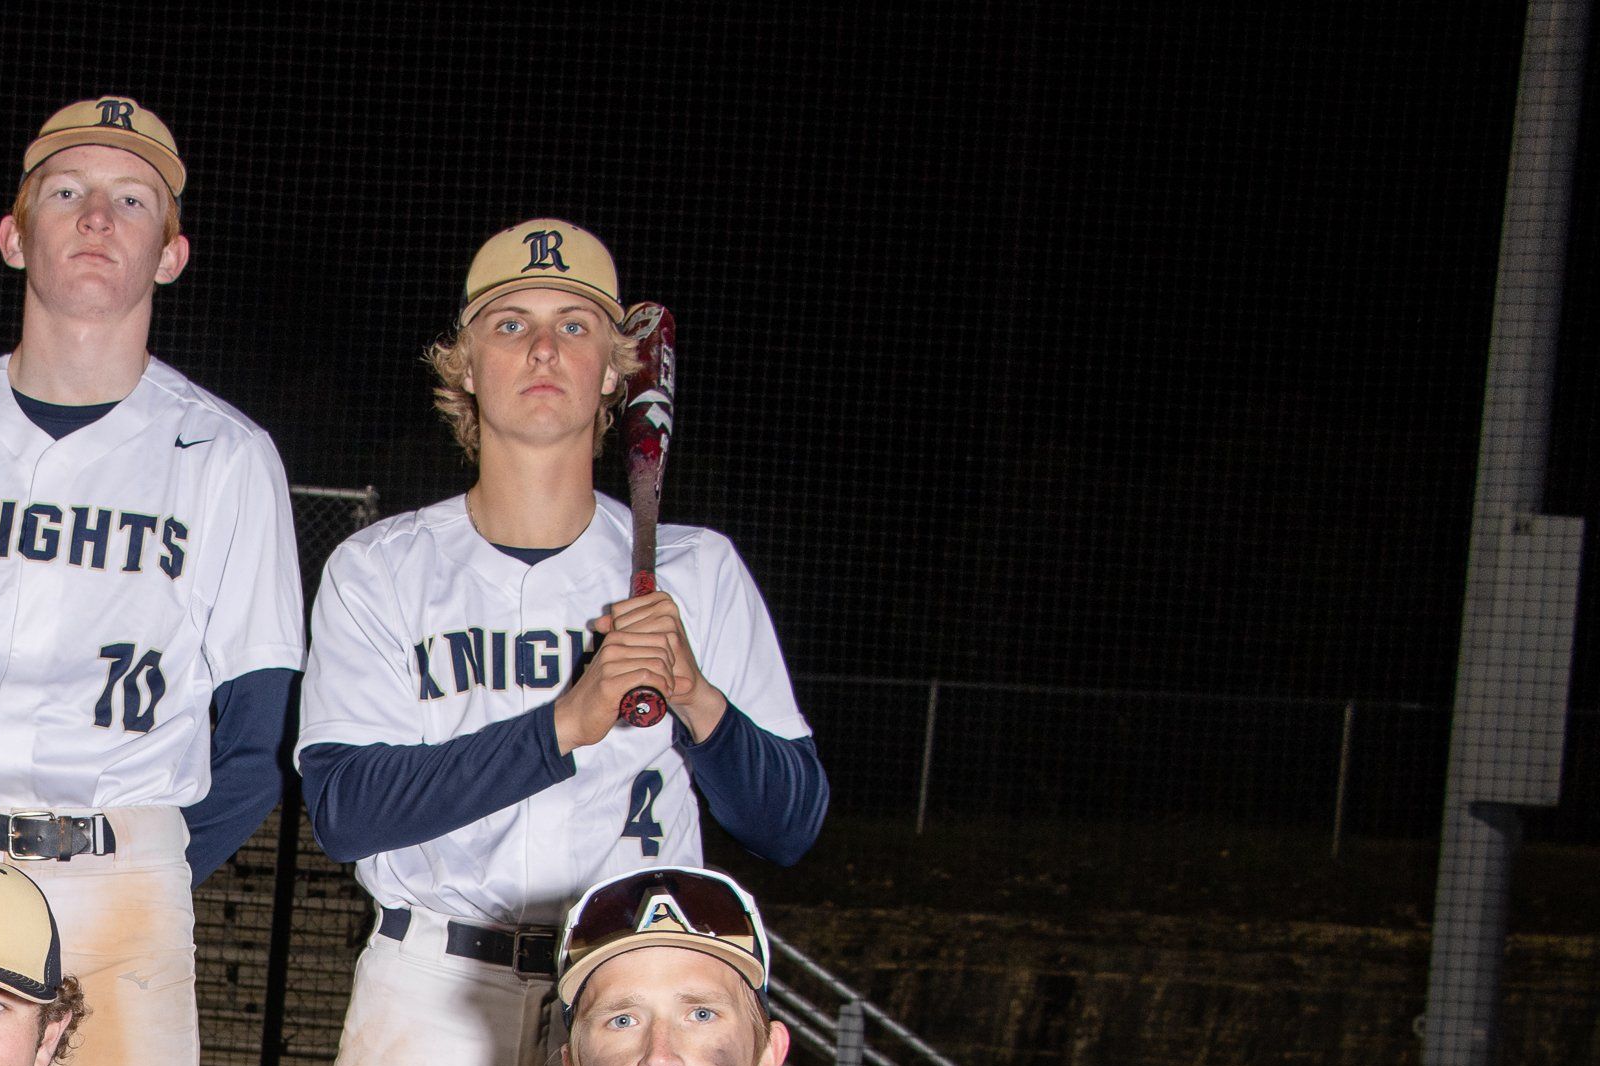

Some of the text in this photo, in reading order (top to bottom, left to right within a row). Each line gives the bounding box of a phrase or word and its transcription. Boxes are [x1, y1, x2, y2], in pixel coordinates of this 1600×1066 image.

[93, 100, 138, 132] R
[521, 230, 570, 273] R
[413, 627, 607, 701] KNIGH
[620, 768, 665, 858] 4
